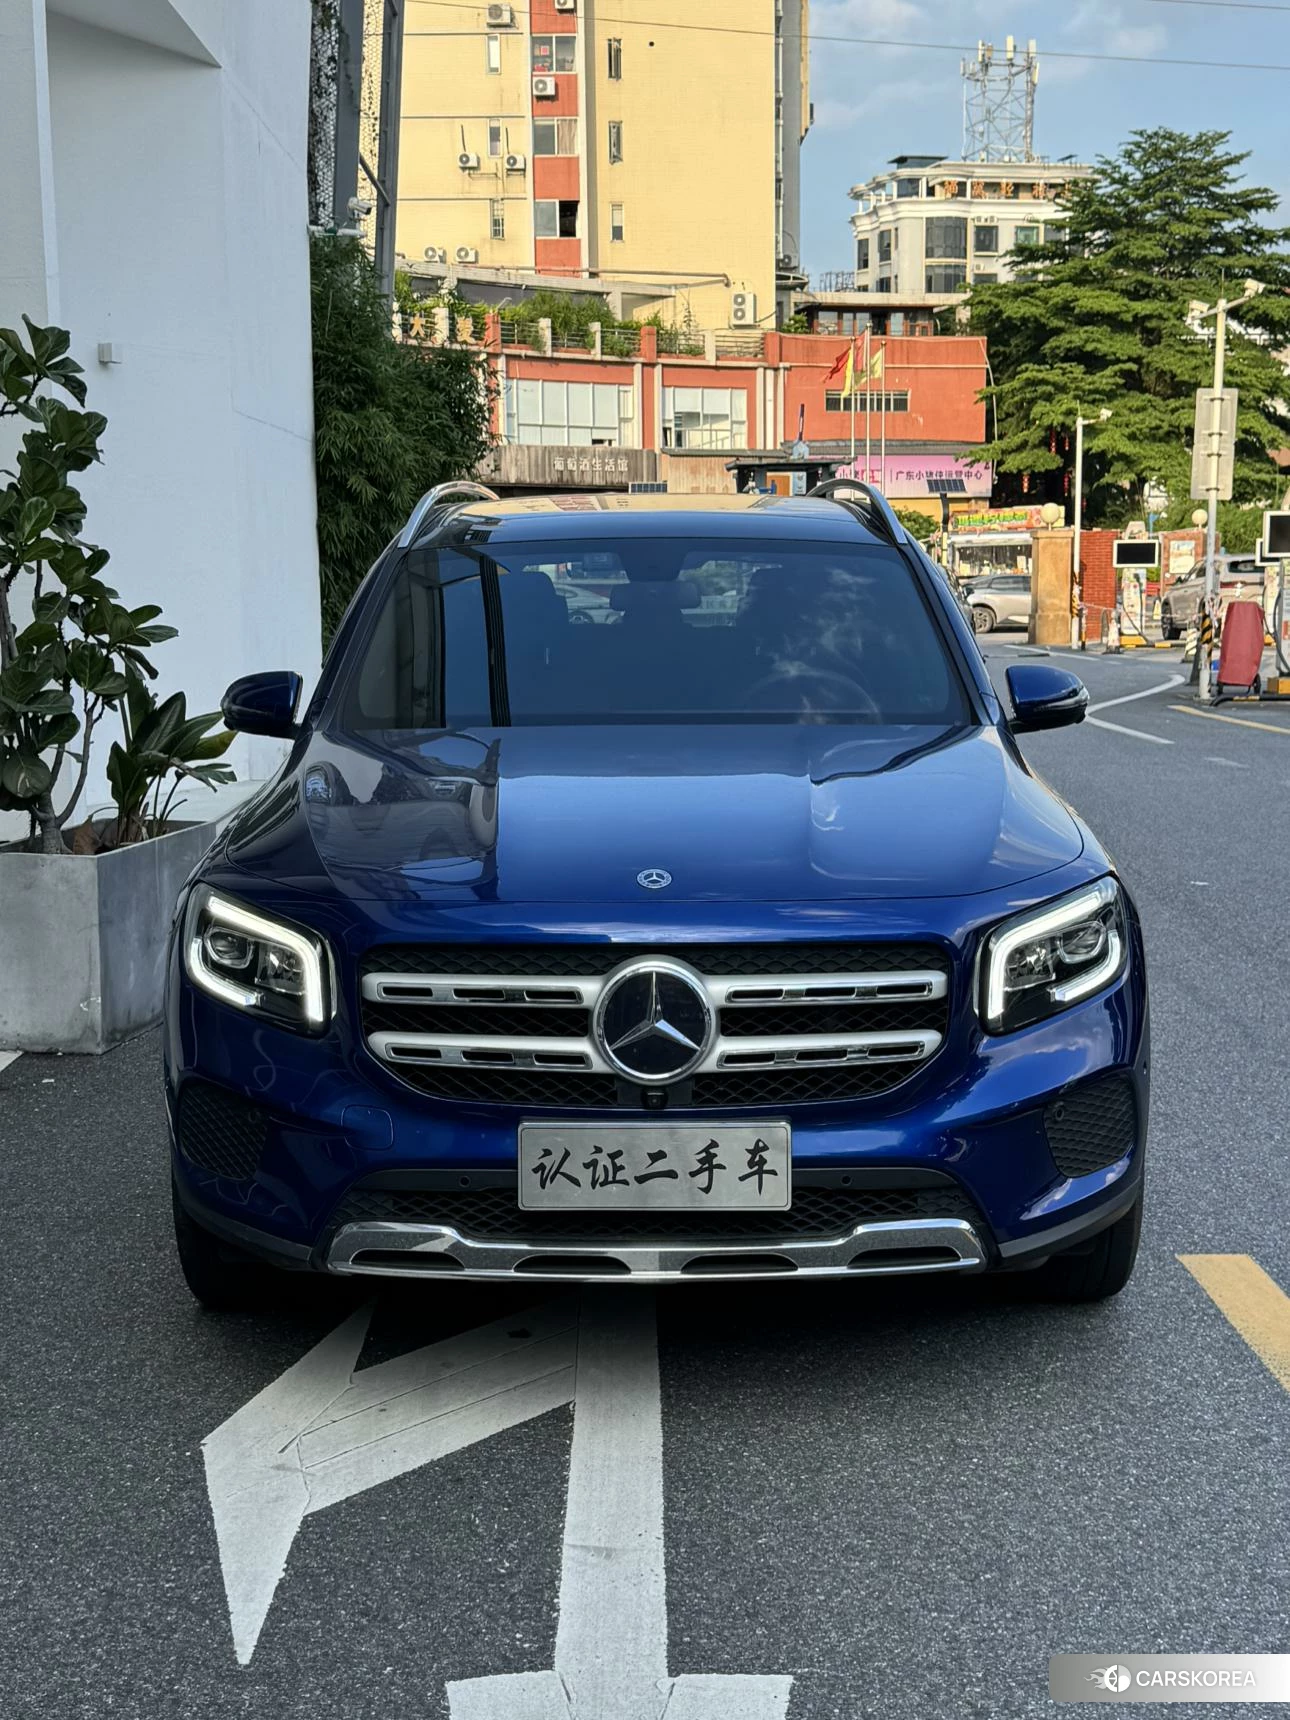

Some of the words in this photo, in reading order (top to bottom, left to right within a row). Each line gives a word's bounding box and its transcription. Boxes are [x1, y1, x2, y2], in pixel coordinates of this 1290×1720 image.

[554, 456, 629, 472] 葡萄酒生活馆
[531, 1138, 778, 1196] 认证二手车
